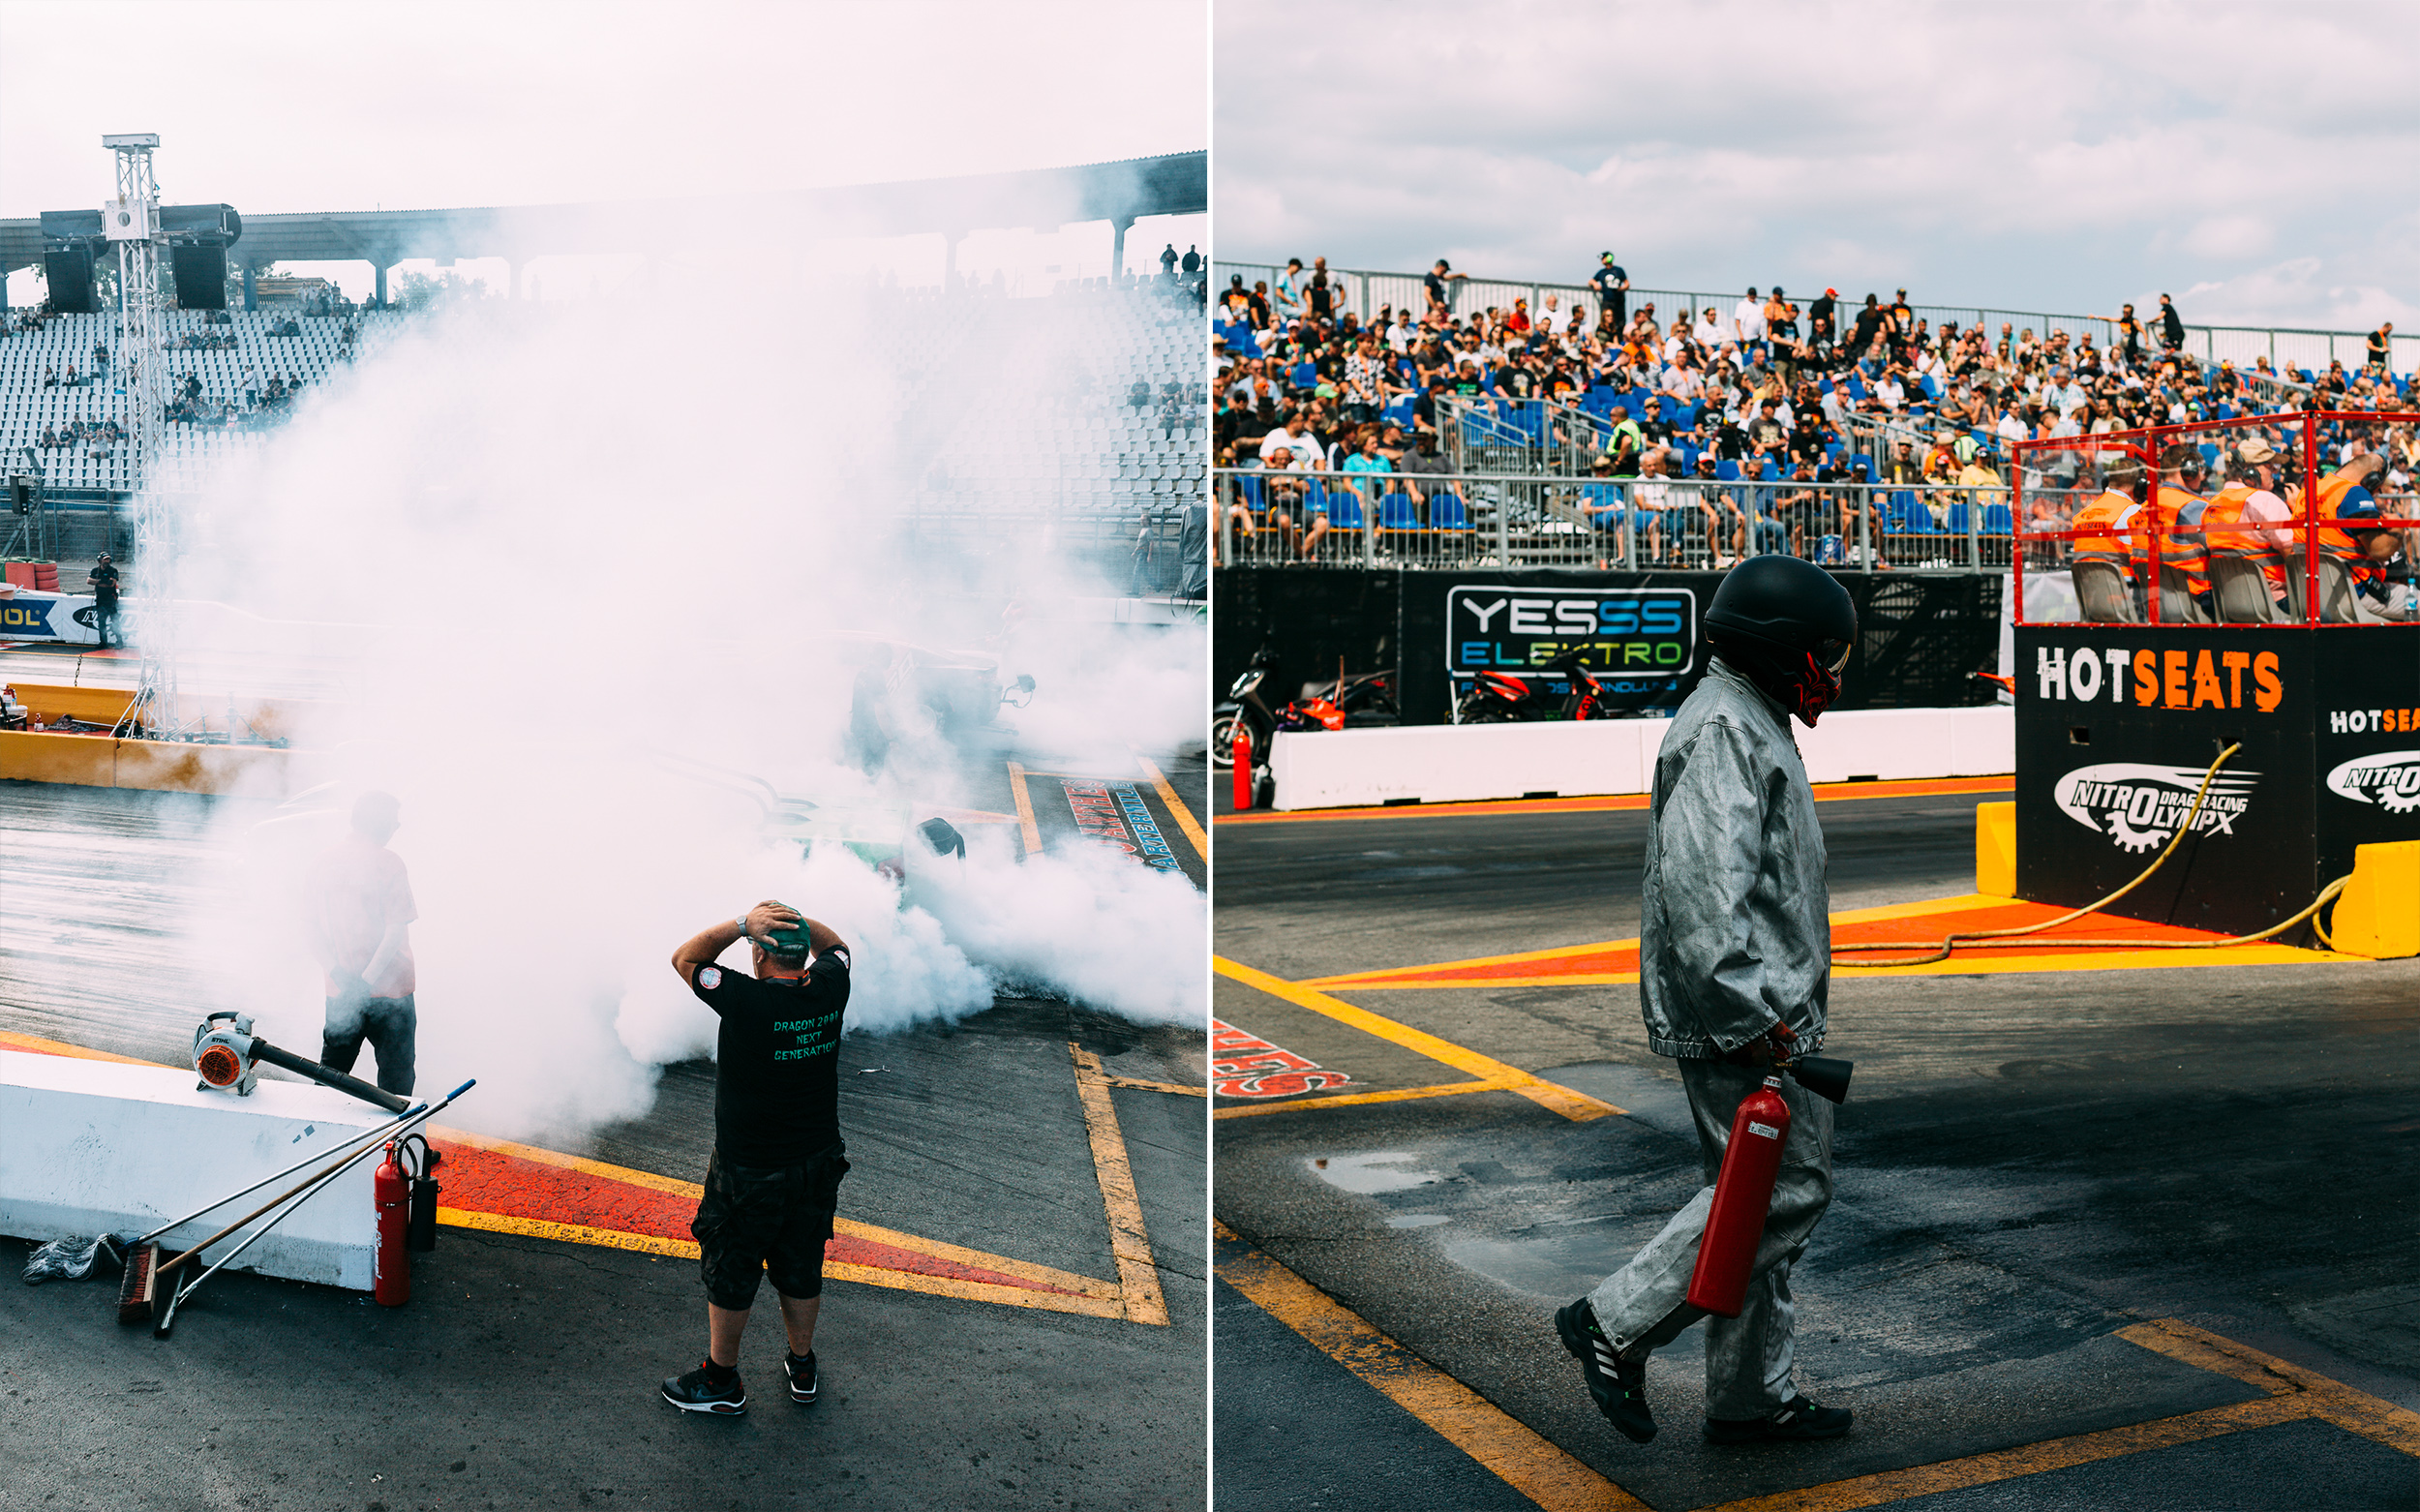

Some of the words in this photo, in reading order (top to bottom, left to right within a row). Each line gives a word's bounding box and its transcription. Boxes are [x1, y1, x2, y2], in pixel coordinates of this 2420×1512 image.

[1463, 597, 1682, 634] YESSS
[2343, 766, 2420, 794] NITRO
[2159, 790, 2194, 808] DRAG
[2199, 795, 2249, 813] RACING
[773, 1018, 815, 1033] DRAGON
[796, 1031, 822, 1046] NEXT
[773, 1039, 837, 1061] GENERATION
